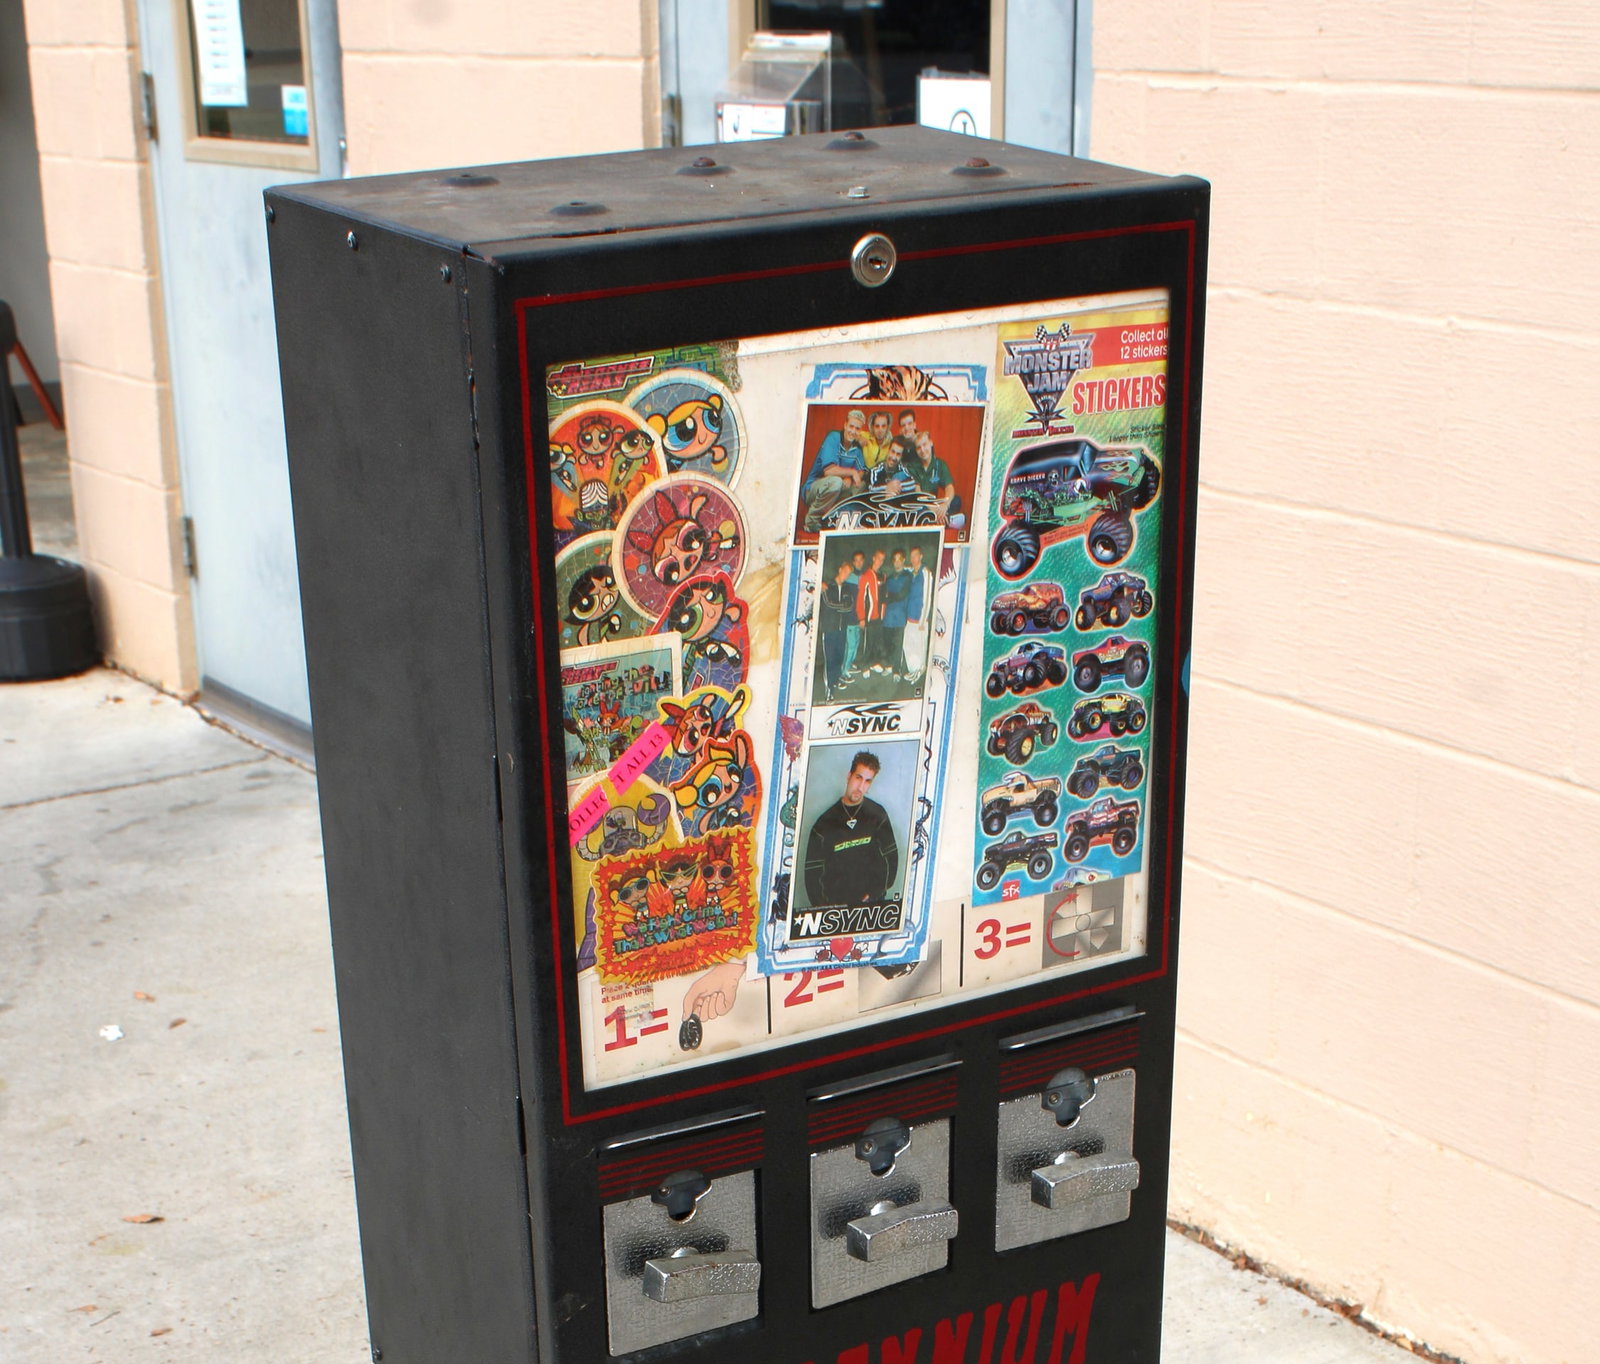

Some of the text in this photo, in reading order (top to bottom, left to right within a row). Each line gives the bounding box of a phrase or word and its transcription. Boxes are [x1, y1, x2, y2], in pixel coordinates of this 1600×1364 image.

[1120, 328, 1155, 344] Collect
[1003, 349, 1092, 376] MONSTER
[1120, 344, 1168, 360] 12 stickers
[1027, 371, 1067, 394] JAM
[1072, 374, 1167, 415] STICKERS
[832, 714, 901, 735] NSYNC
[626, 750, 648, 775] ALL
[650, 734, 663, 749] 13
[1002, 884, 1020, 898] sfx
[799, 904, 900, 936] NSYNC
